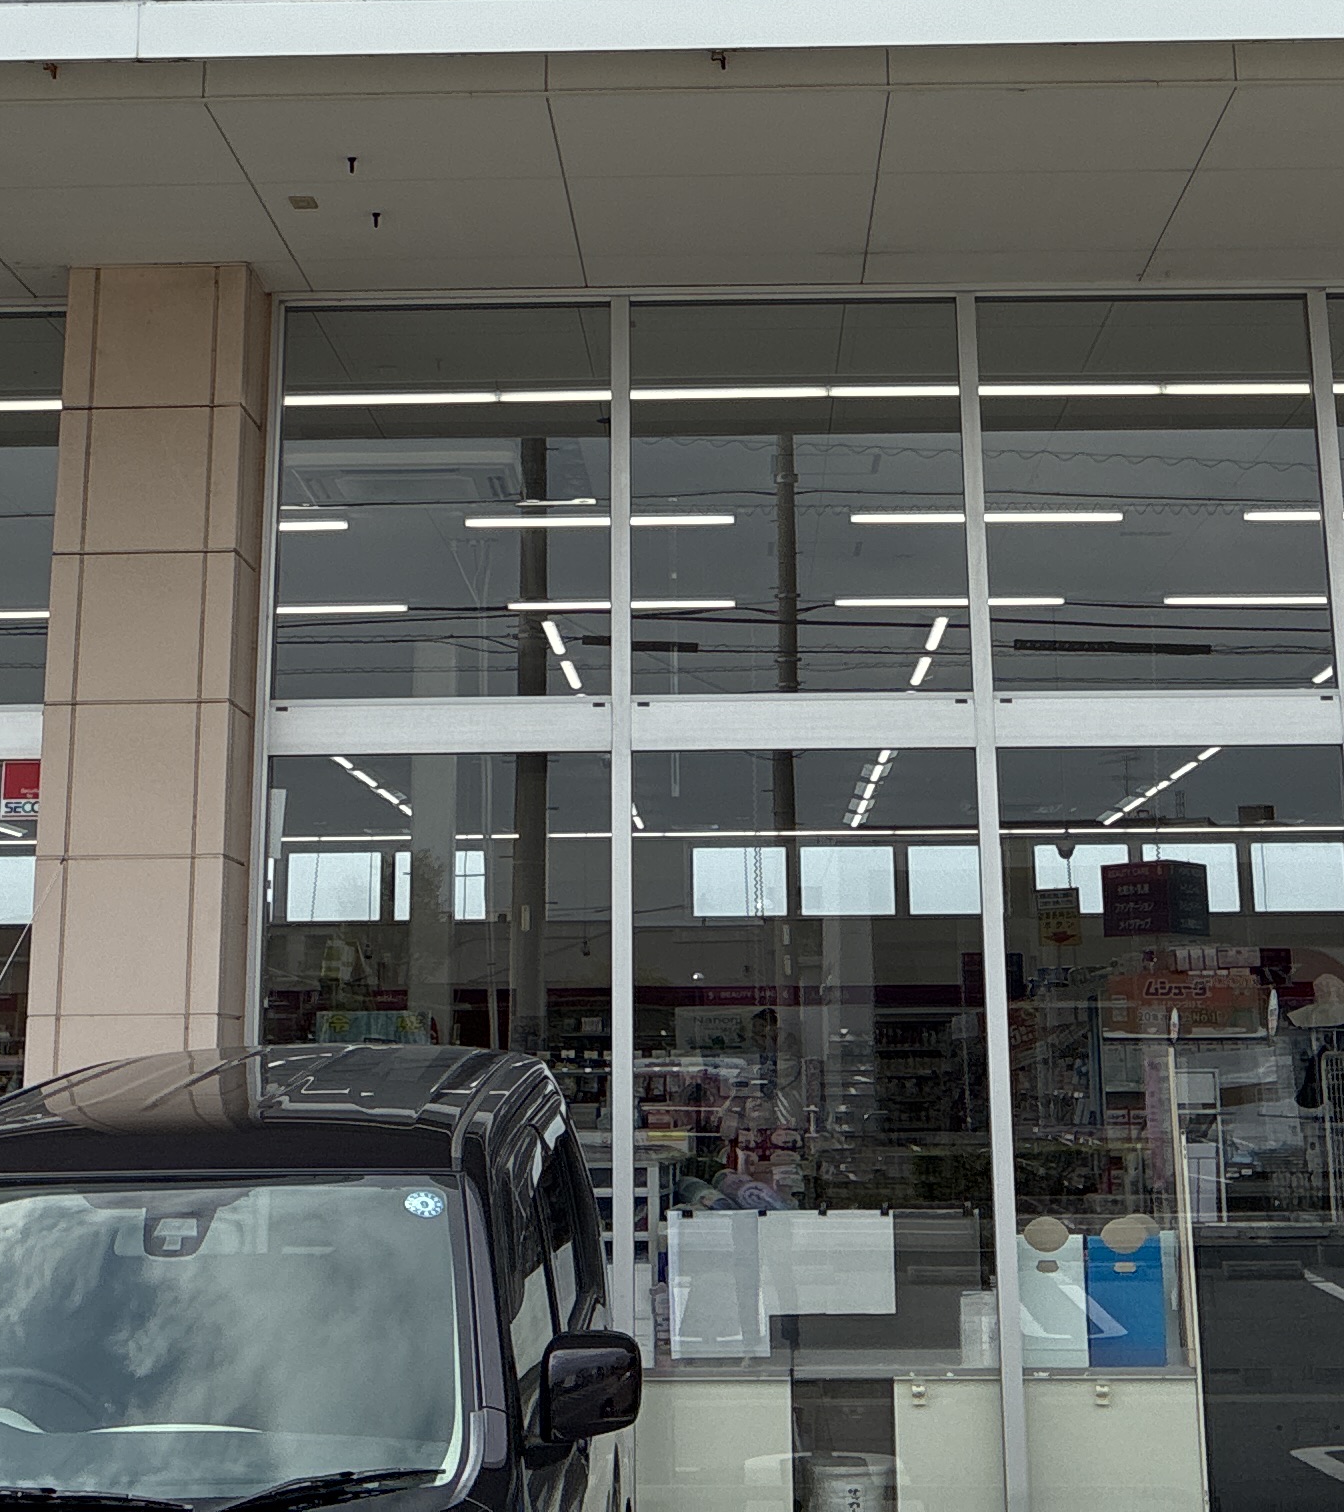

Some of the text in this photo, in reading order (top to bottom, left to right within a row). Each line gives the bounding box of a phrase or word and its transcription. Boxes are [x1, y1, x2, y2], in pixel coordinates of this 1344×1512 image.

[5, 801, 40, 813] SECO
[1144, 979, 1209, 999] ムシューダ
